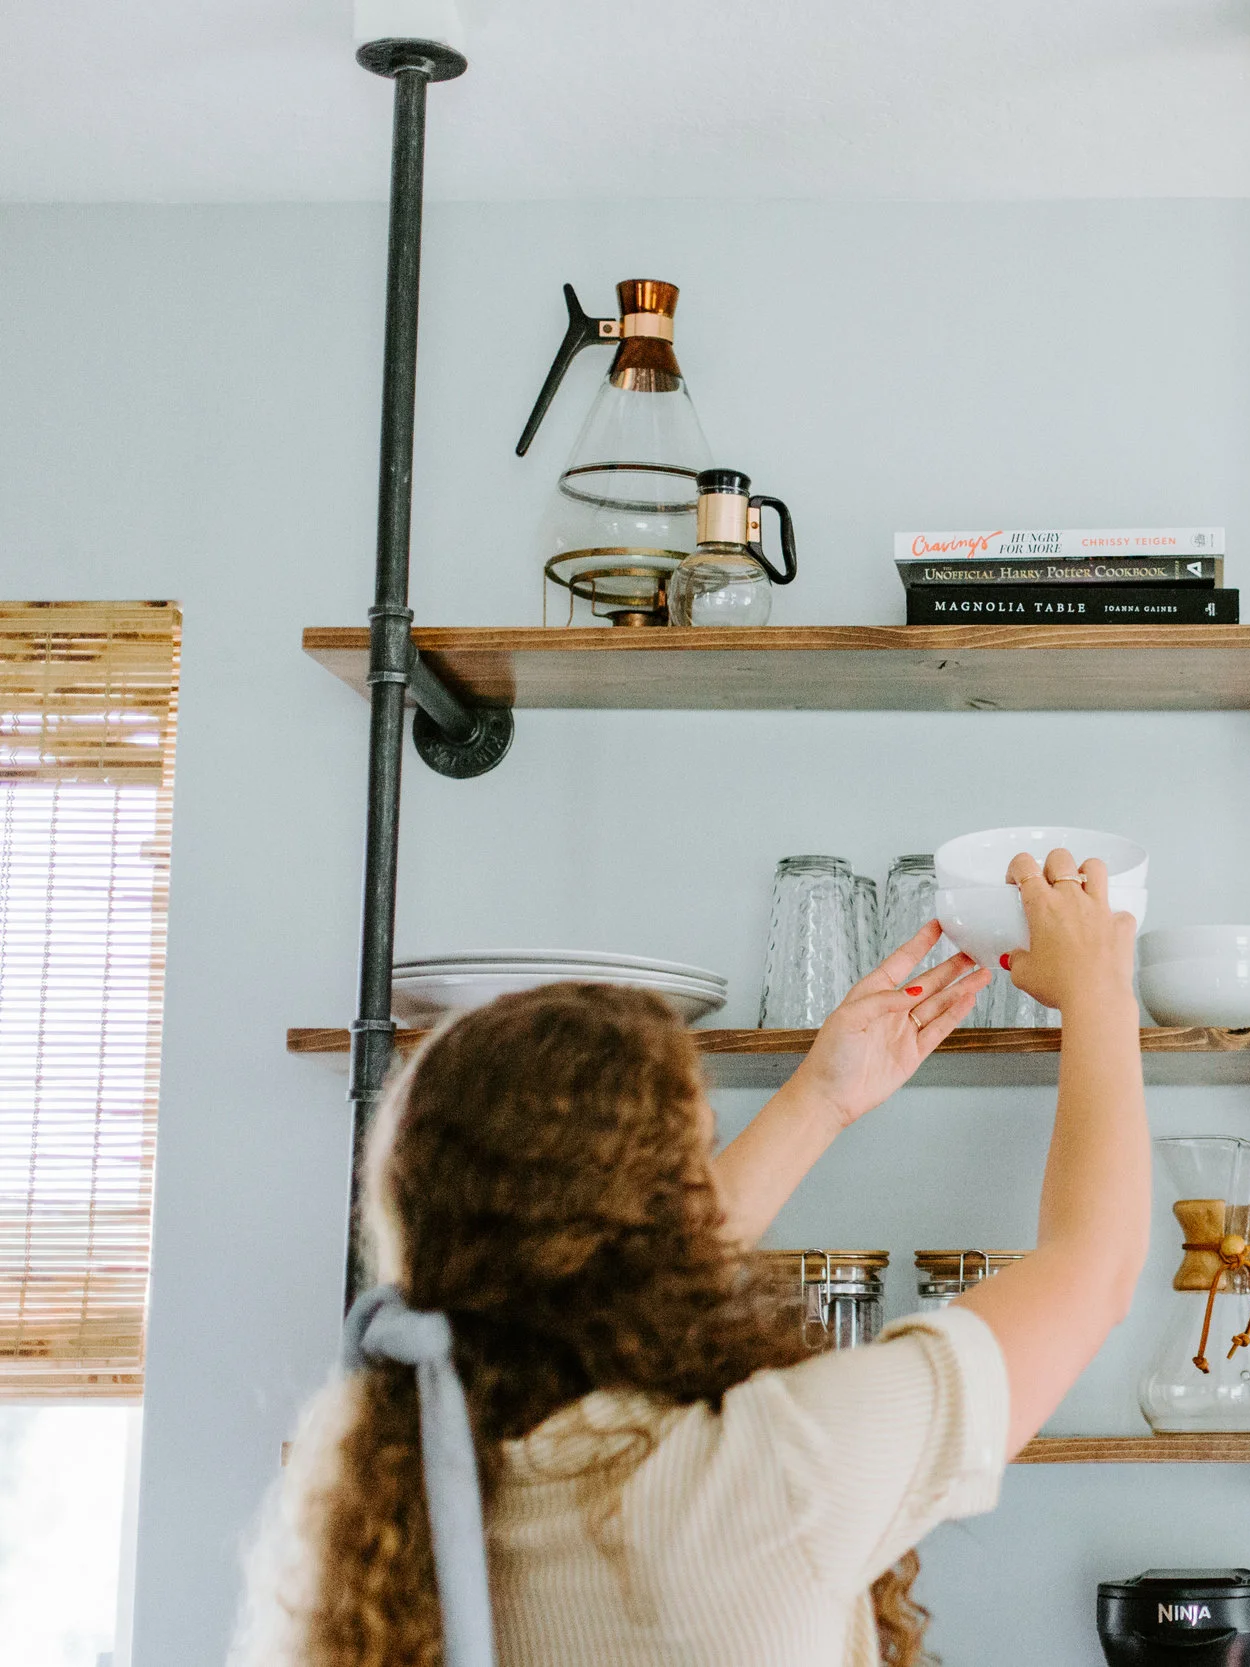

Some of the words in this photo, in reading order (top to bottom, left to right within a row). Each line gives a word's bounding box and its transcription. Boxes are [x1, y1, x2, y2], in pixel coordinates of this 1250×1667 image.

[1011, 533, 1062, 543] HUNGRY
[1081, 538, 1130, 546] CHRISSY
[1135, 537, 1176, 545] TEIGEN
[912, 531, 1003, 558] Cravings
[1000, 544, 1023, 554] FOR
[1026, 543, 1062, 553] MORE
[934, 601, 1025, 612] MAGNOLIA
[1034, 602, 1086, 613] TABLE
[1158, 1602, 1211, 1626] NINJA
